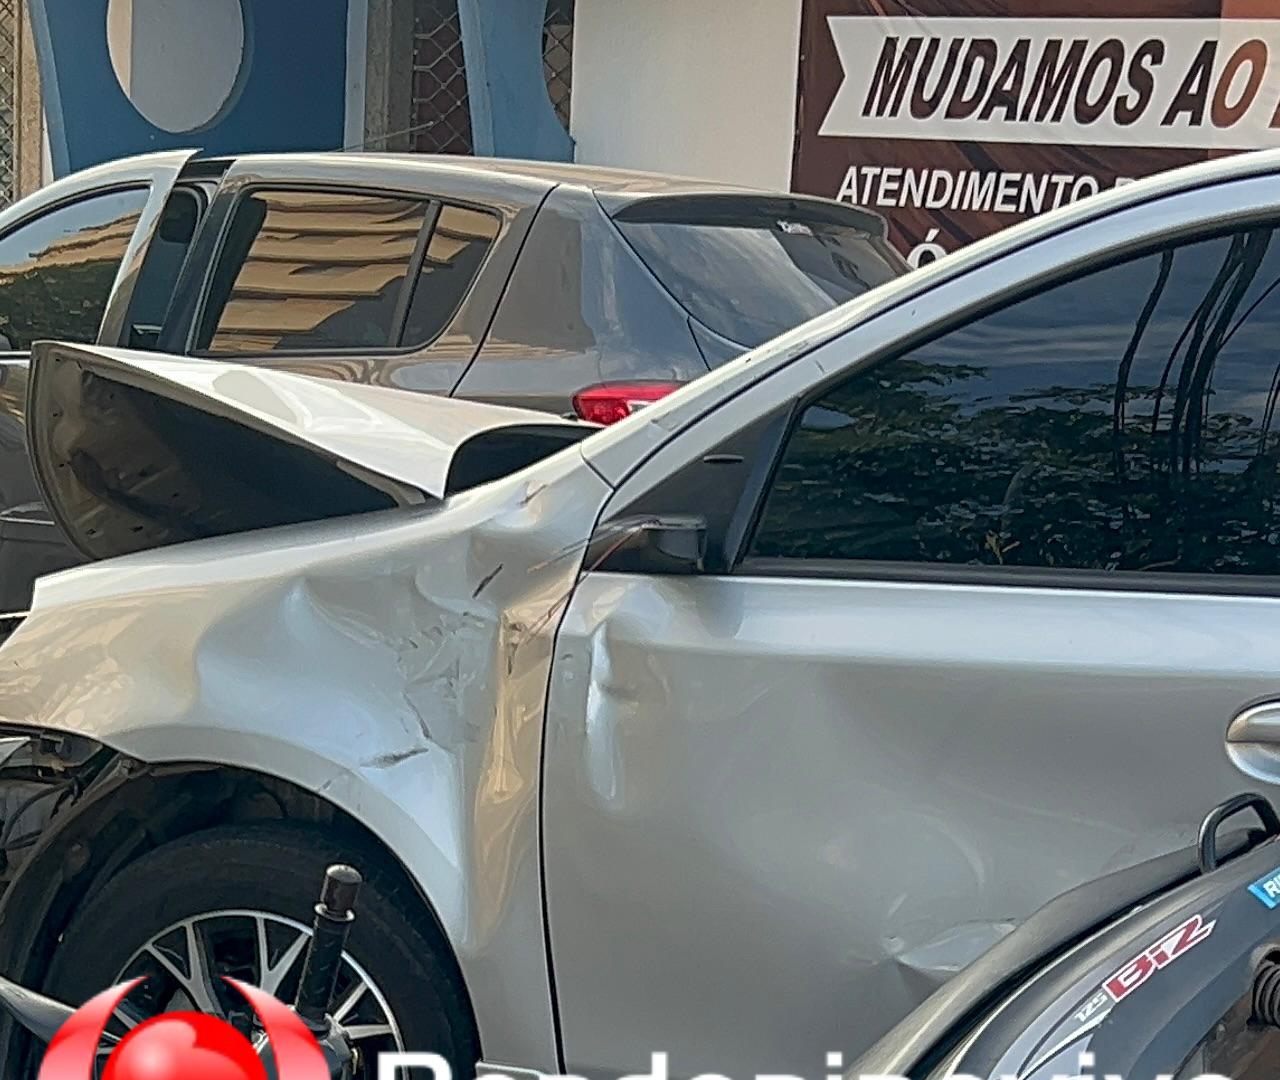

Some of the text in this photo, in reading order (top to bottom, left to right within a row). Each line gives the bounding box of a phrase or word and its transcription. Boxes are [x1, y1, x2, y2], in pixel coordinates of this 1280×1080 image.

[861, 36, 1165, 127] MUDAMOS
[1160, 38, 1268, 129] AO
[836, 166, 1099, 213] ATENDIMENTO
